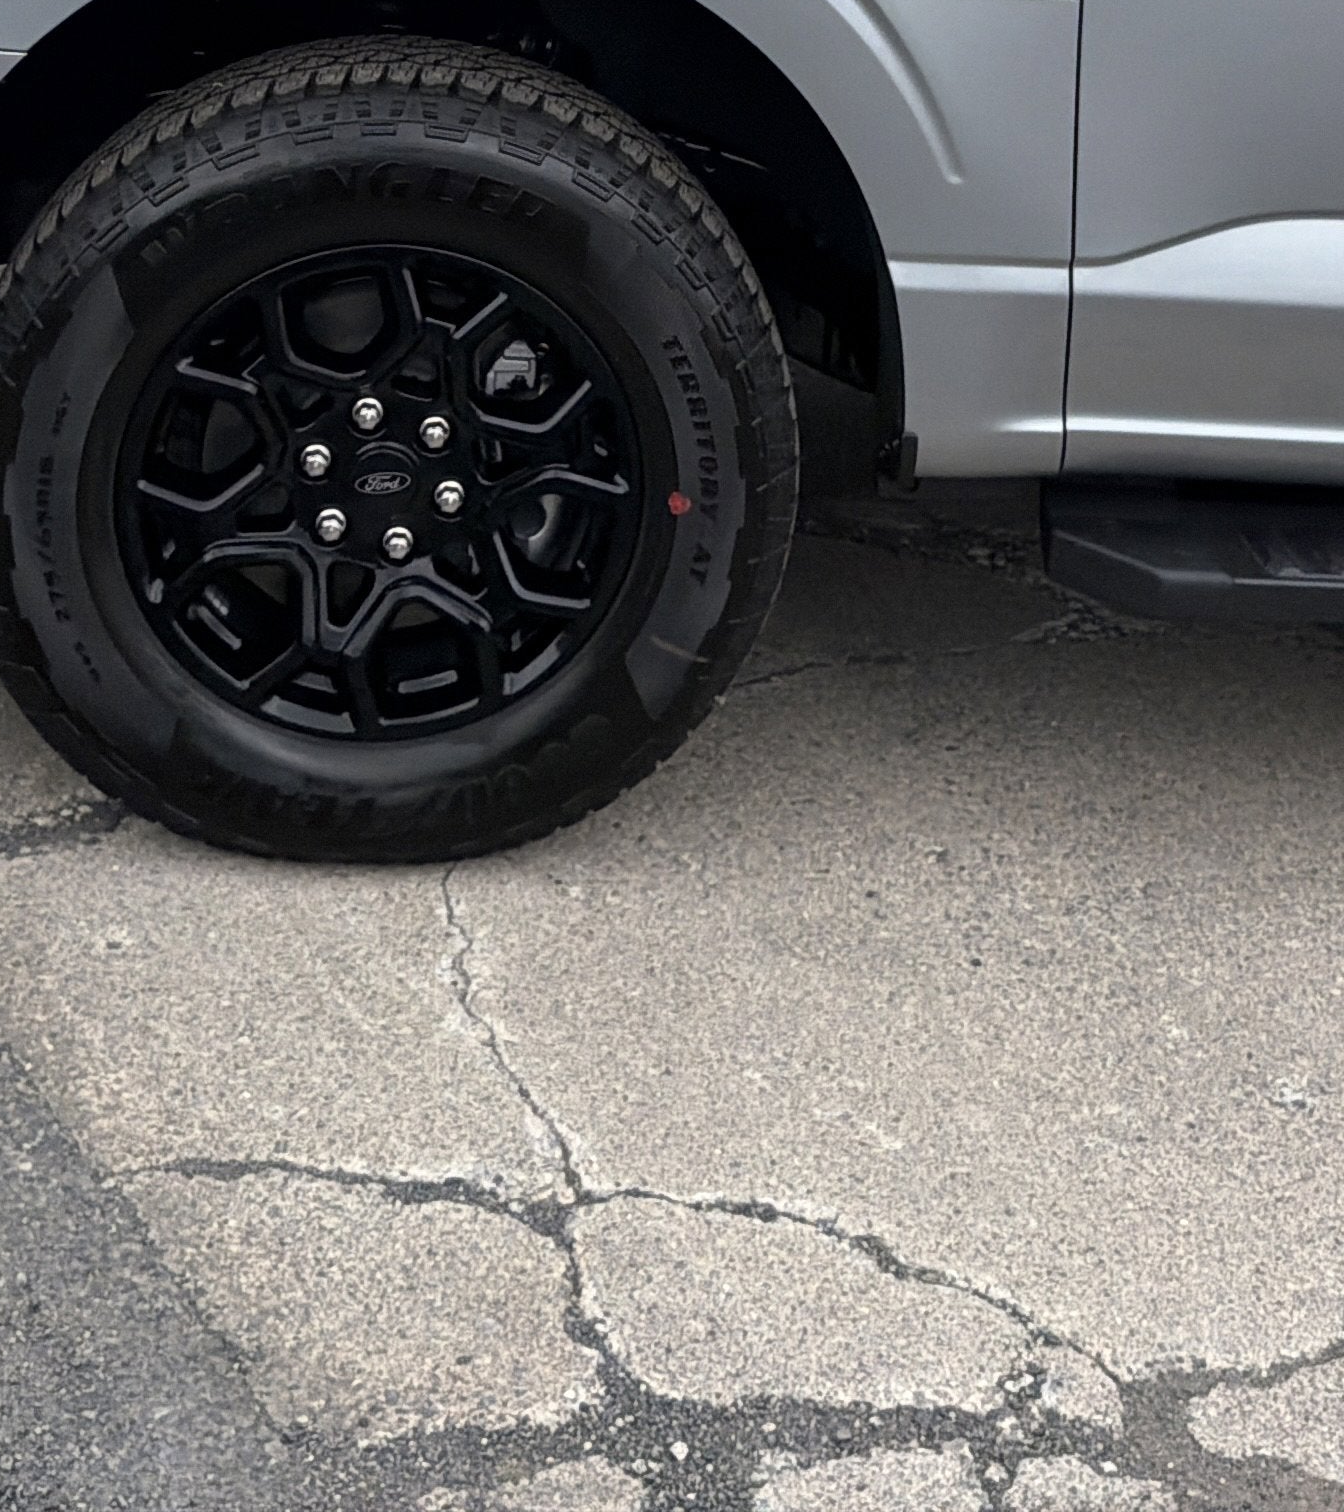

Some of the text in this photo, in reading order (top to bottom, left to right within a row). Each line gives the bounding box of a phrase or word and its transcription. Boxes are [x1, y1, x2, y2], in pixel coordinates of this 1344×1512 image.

[360, 473, 406, 493] Ford
[661, 335, 719, 586] TERRITORY AT
